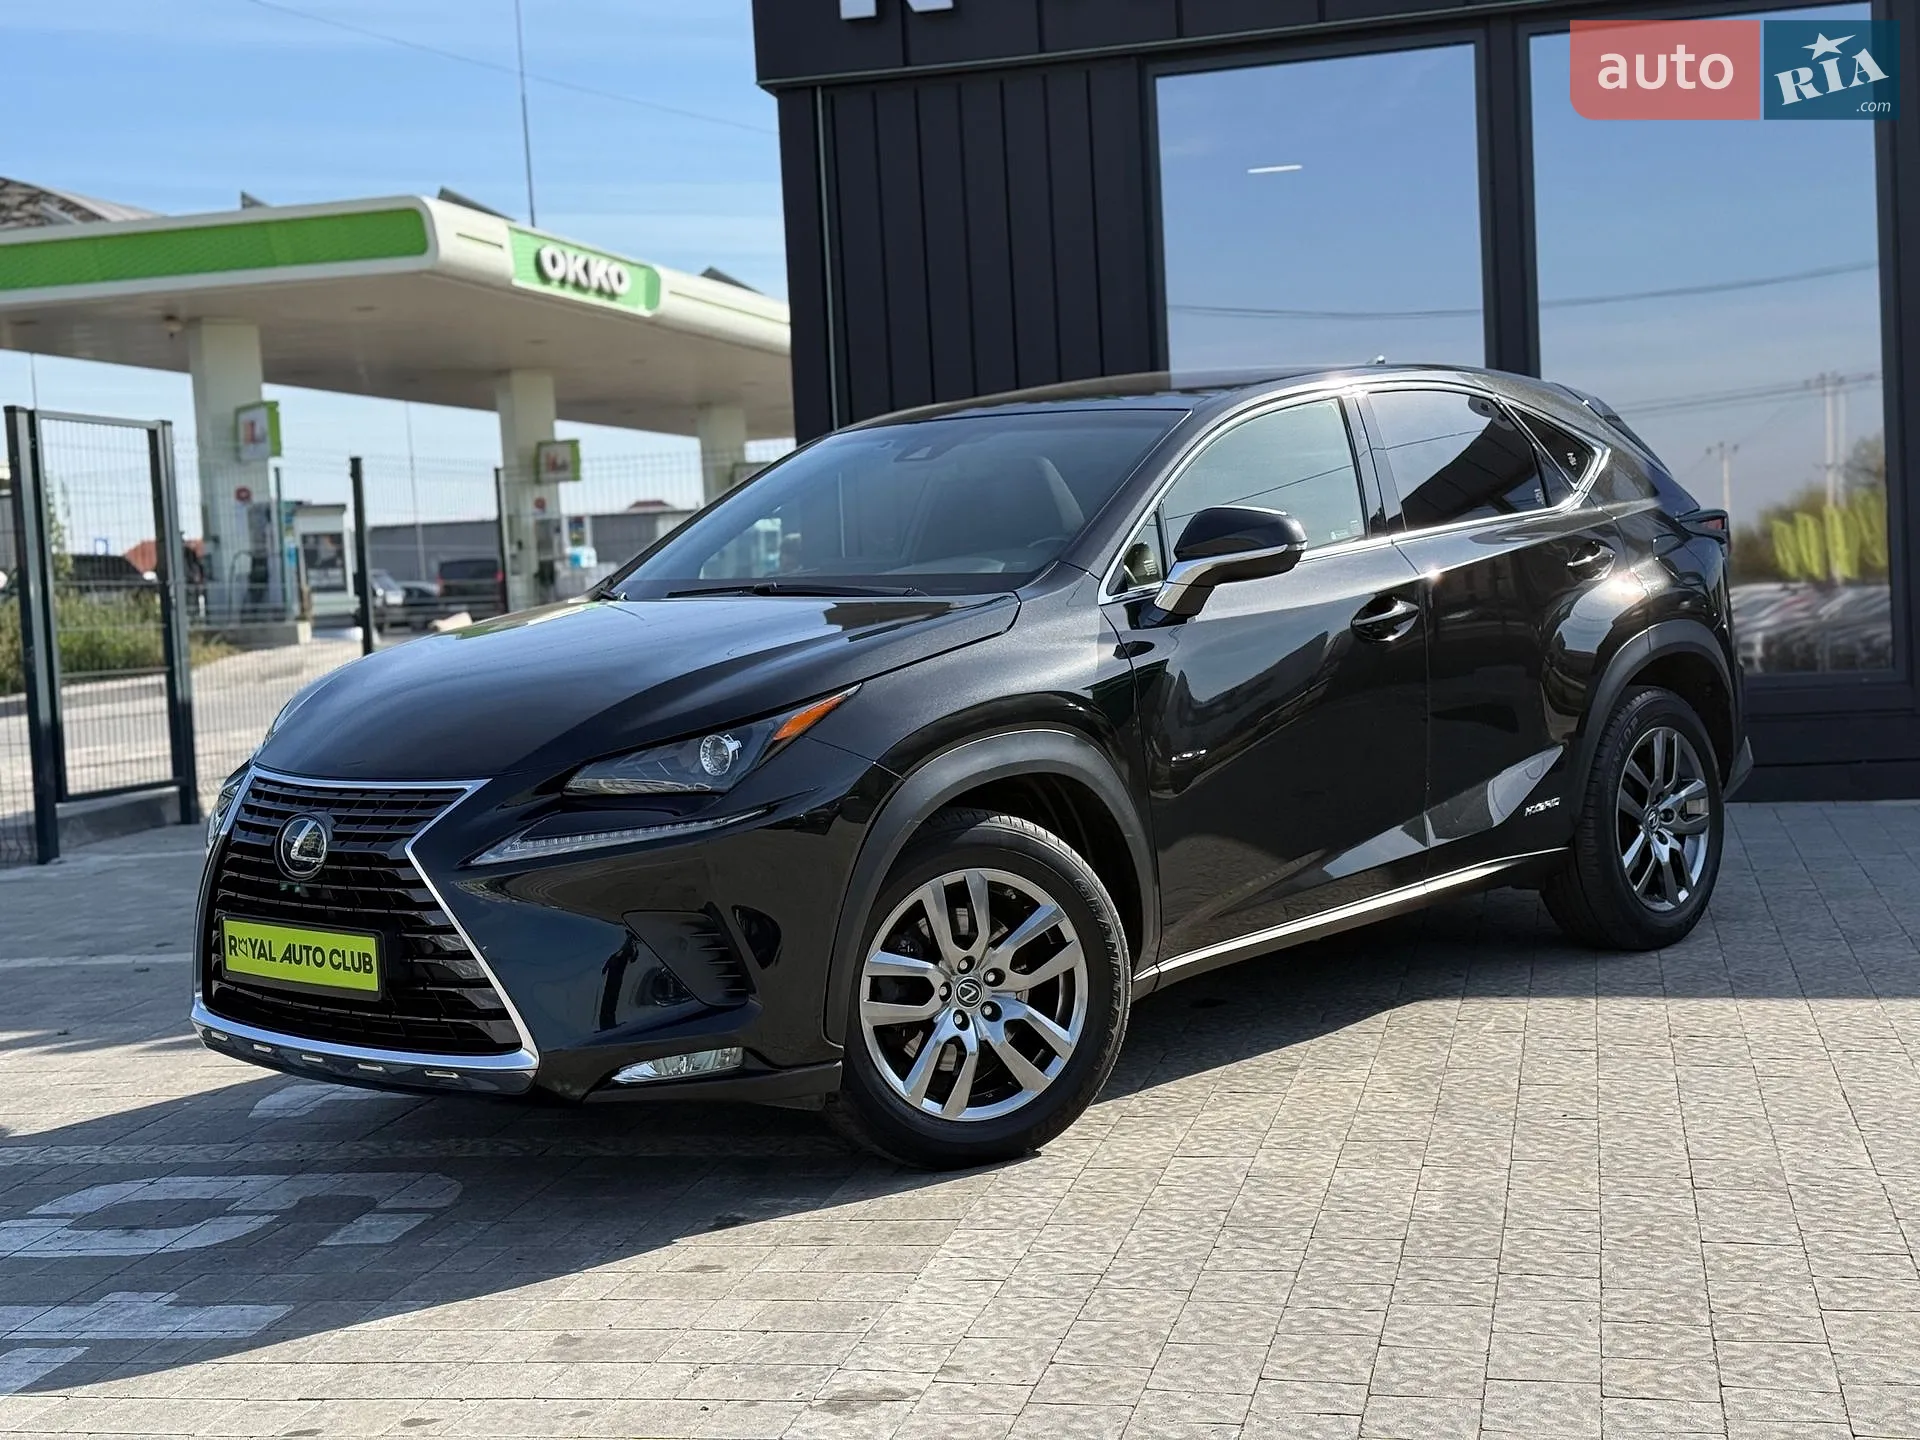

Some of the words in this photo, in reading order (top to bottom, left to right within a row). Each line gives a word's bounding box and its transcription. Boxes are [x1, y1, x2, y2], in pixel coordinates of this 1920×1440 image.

[537, 243, 632, 296] OKKO
[280, 942, 326, 968] AUTO
[329, 948, 374, 975] CLUB
